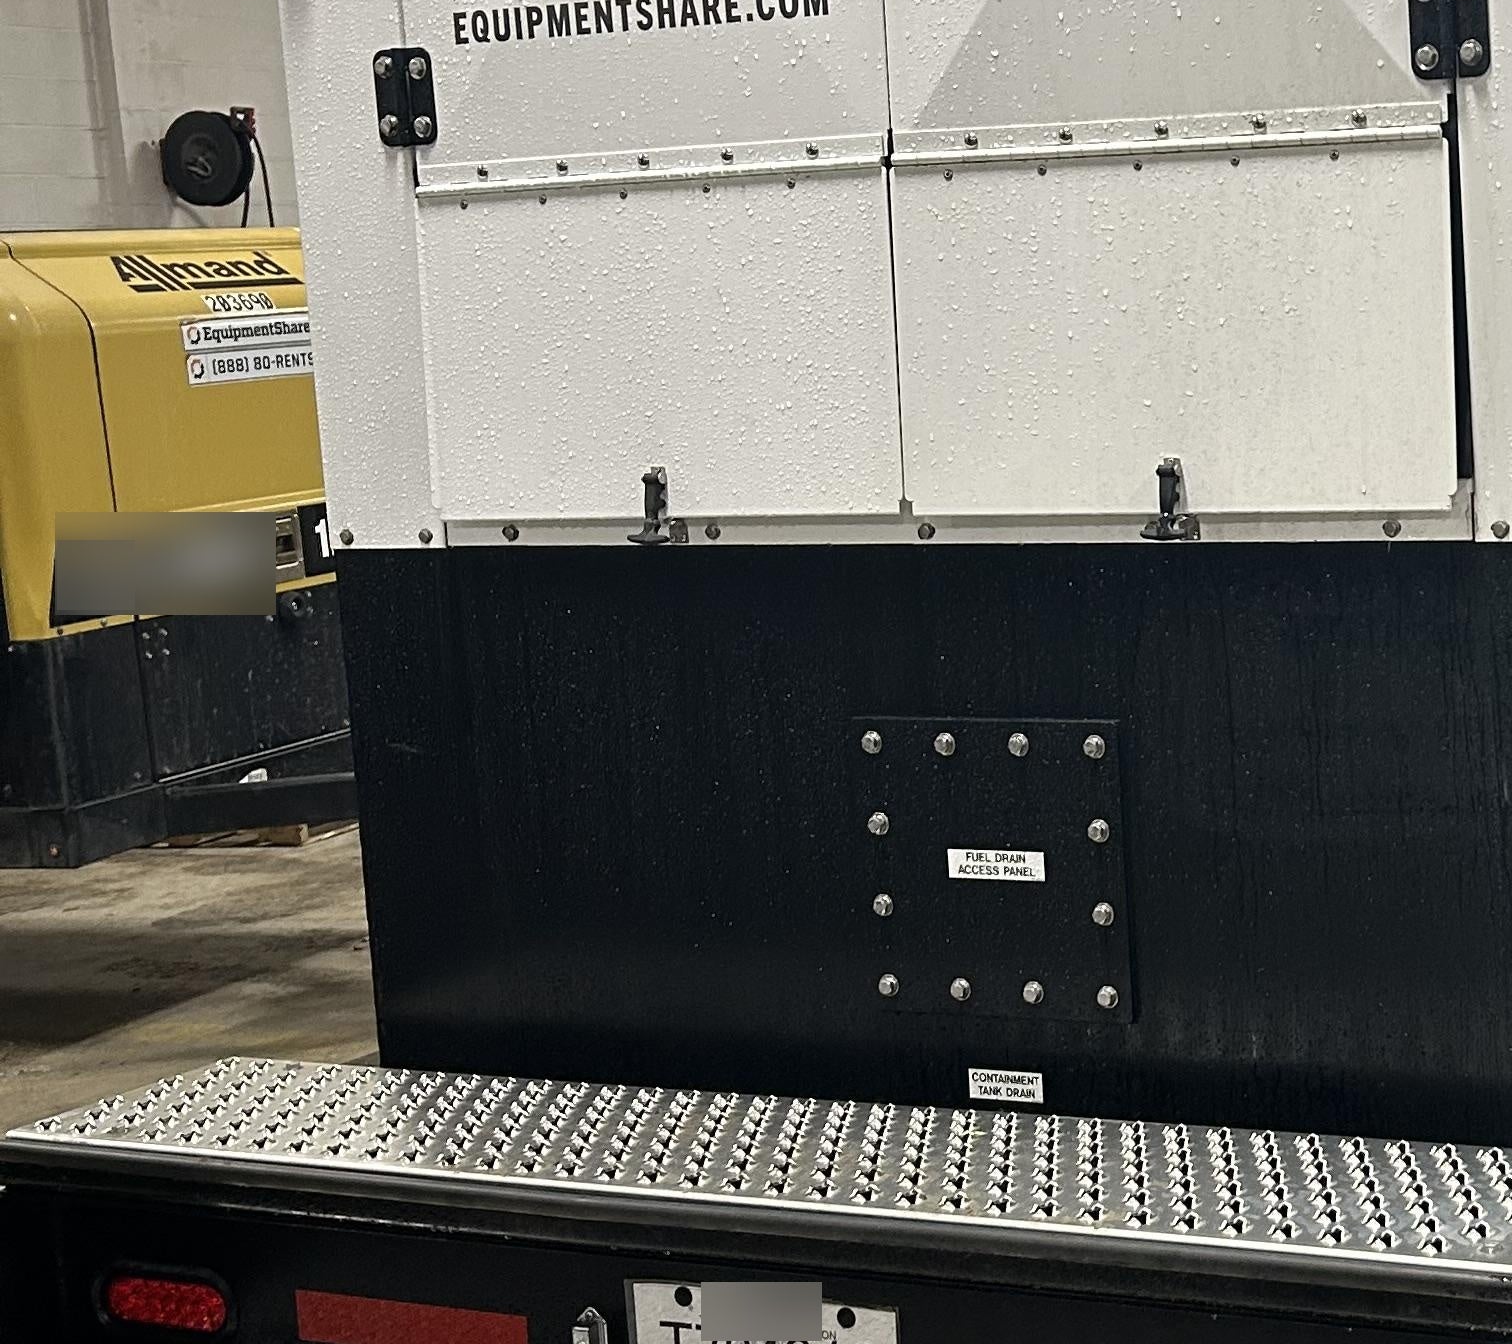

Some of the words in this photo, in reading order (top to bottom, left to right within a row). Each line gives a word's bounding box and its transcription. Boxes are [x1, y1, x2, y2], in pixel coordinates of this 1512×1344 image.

[110, 251, 291, 292] Allmand
[204, 292, 274, 313] 203690
[203, 320, 311, 342] EquipmentShare
[212, 357, 250, 376] (888)
[966, 851, 991, 863] FUEL
[995, 852, 1026, 864] DRAIN
[958, 864, 999, 876] ACCESS
[1003, 866, 1036, 877] PANEL
[971, 1071, 1040, 1086] CONTAINMENT
[978, 1085, 1002, 1096] TANK
[1006, 1087, 1036, 1099] DRAIN
